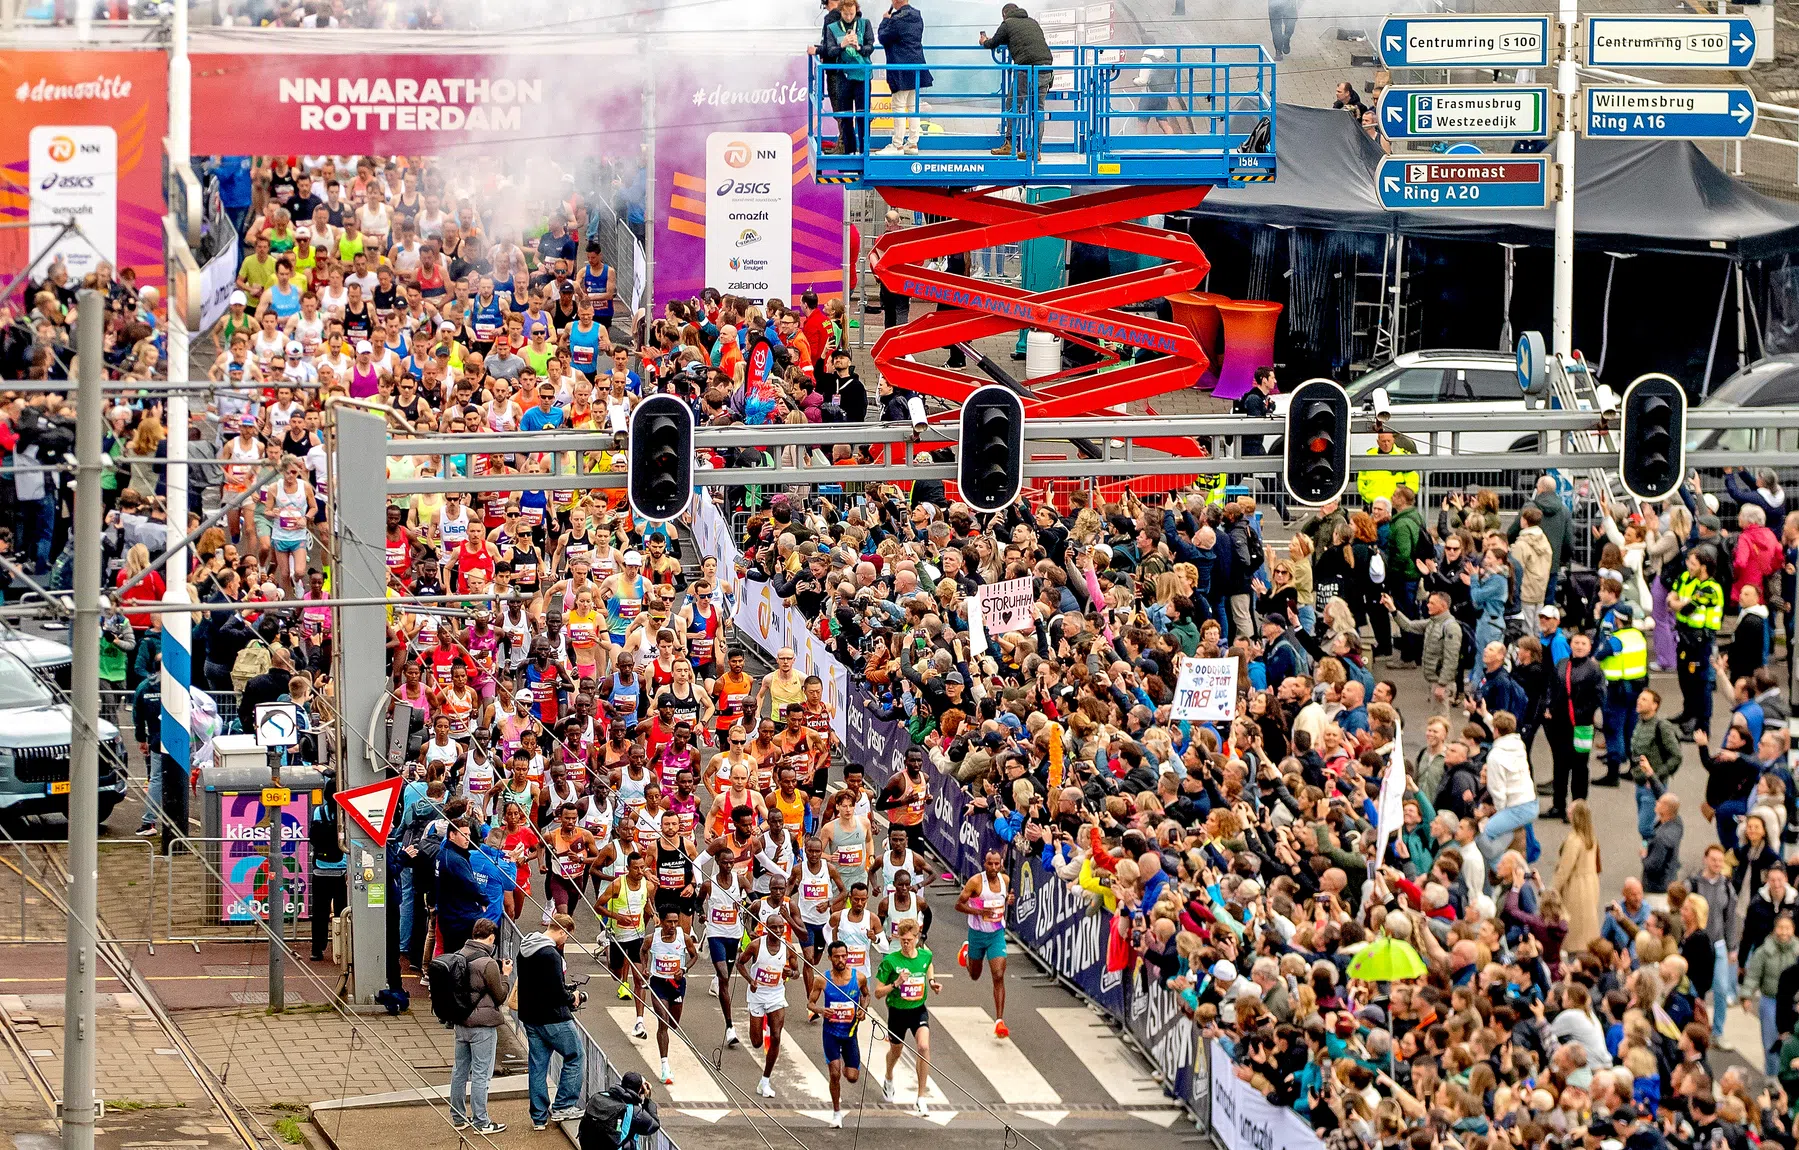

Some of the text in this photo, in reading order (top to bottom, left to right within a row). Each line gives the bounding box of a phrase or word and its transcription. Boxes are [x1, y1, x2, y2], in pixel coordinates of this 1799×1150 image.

[1409, 36, 1536, 50] Centrumring S 100
[1596, 36, 1724, 50] Centrumring S 100
[15, 74, 132, 102] #demooiste
[279, 78, 542, 104] NN MARATHON
[692, 80, 808, 107] #demooiste
[1436, 98, 1521, 112] Erasmusbrug
[1595, 94, 1695, 111] Willemsbrug
[300, 105, 521, 131] ROTTERDAM
[1436, 115, 1517, 129] Westzeedijk
[1592, 115, 1627, 132] Ring
[757, 150, 777, 159] NN
[924, 164, 985, 173] PEINEMANN
[1238, 157, 1259, 168] 1584
[1430, 164, 1506, 179] Euromast
[58, 176, 95, 189] asics
[734, 182, 771, 194] asics
[1404, 186, 1440, 202] Ring
[728, 210, 769, 221] amazfit
[728, 281, 769, 290] zalando
[903, 279, 1180, 354] PEINEMANN.NL PEINEMANN.NL
[443, 526, 467, 534] USA
[226, 822, 304, 839] klassek
[759, 972, 778, 980] PACE
